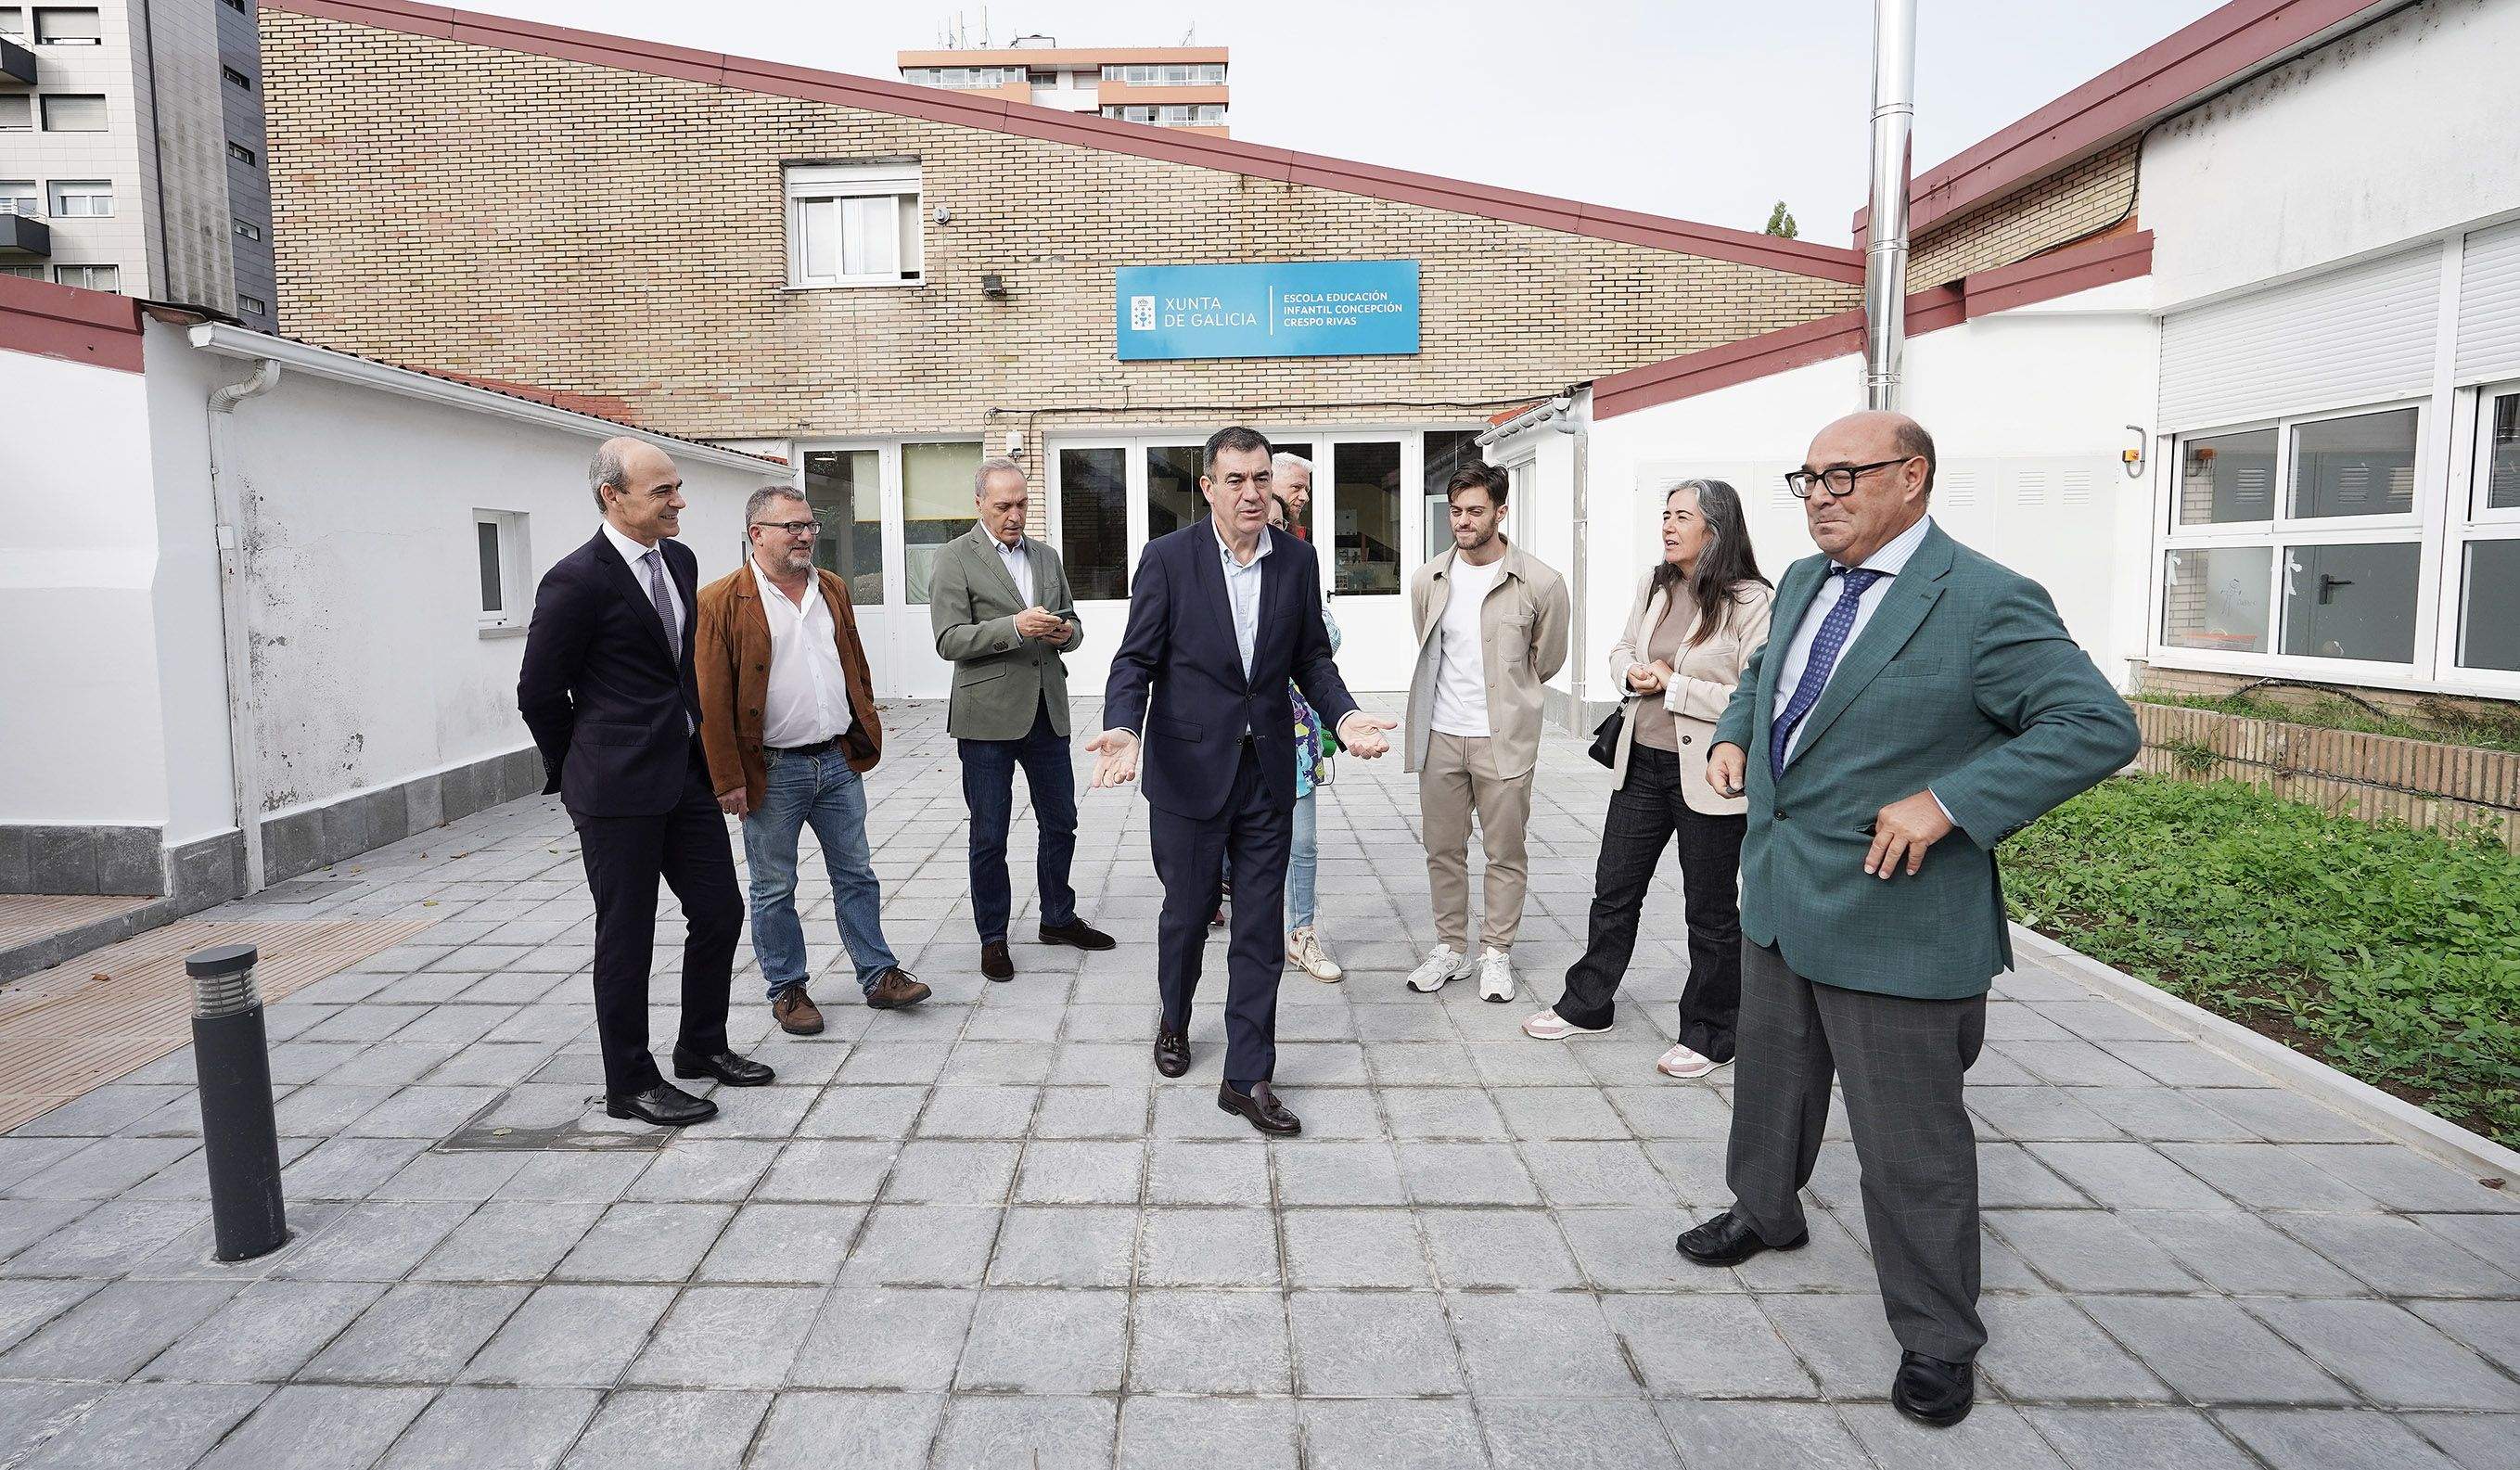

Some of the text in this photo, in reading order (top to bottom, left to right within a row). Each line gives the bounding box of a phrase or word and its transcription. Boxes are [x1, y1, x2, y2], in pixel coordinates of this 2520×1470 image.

[1284, 289, 1388, 303] ESCOLA EDUCACIÓN
[1165, 297, 1222, 311] XUNTA
[1284, 301, 1402, 315] INFANTIL CONCEPCIÓN
[1164, 313, 1258, 327] DE GALICIA
[1284, 316, 1357, 327] CRESPO RIVAS
[1445, 962, 1454, 971] N
